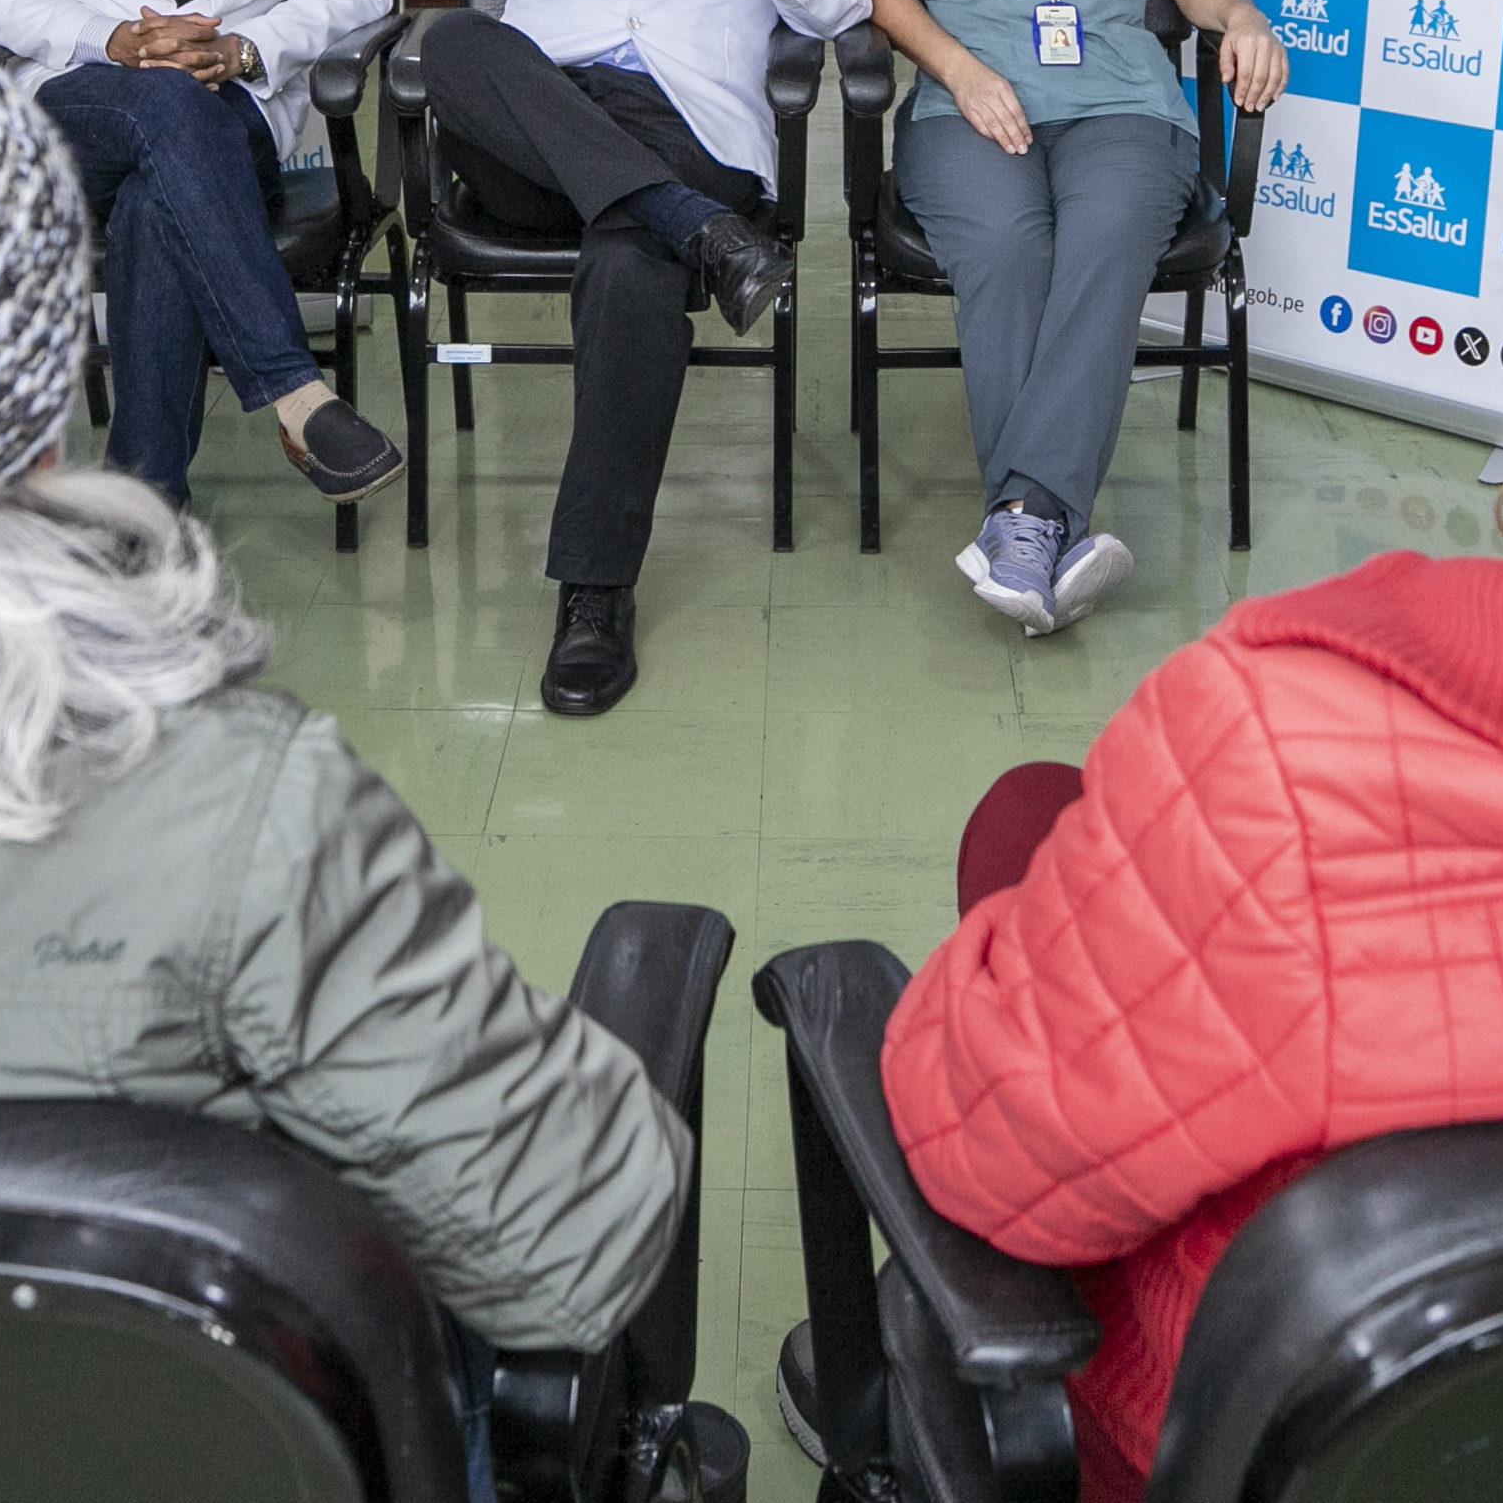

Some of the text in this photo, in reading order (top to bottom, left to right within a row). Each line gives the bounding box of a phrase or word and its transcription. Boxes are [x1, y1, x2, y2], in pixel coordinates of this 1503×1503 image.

[1268, 19, 1350, 57] sSalud
[1382, 40, 1482, 77] EsSalud
[1254, 179, 1336, 218] sSalud
[1367, 200, 1468, 247] EsSalud
